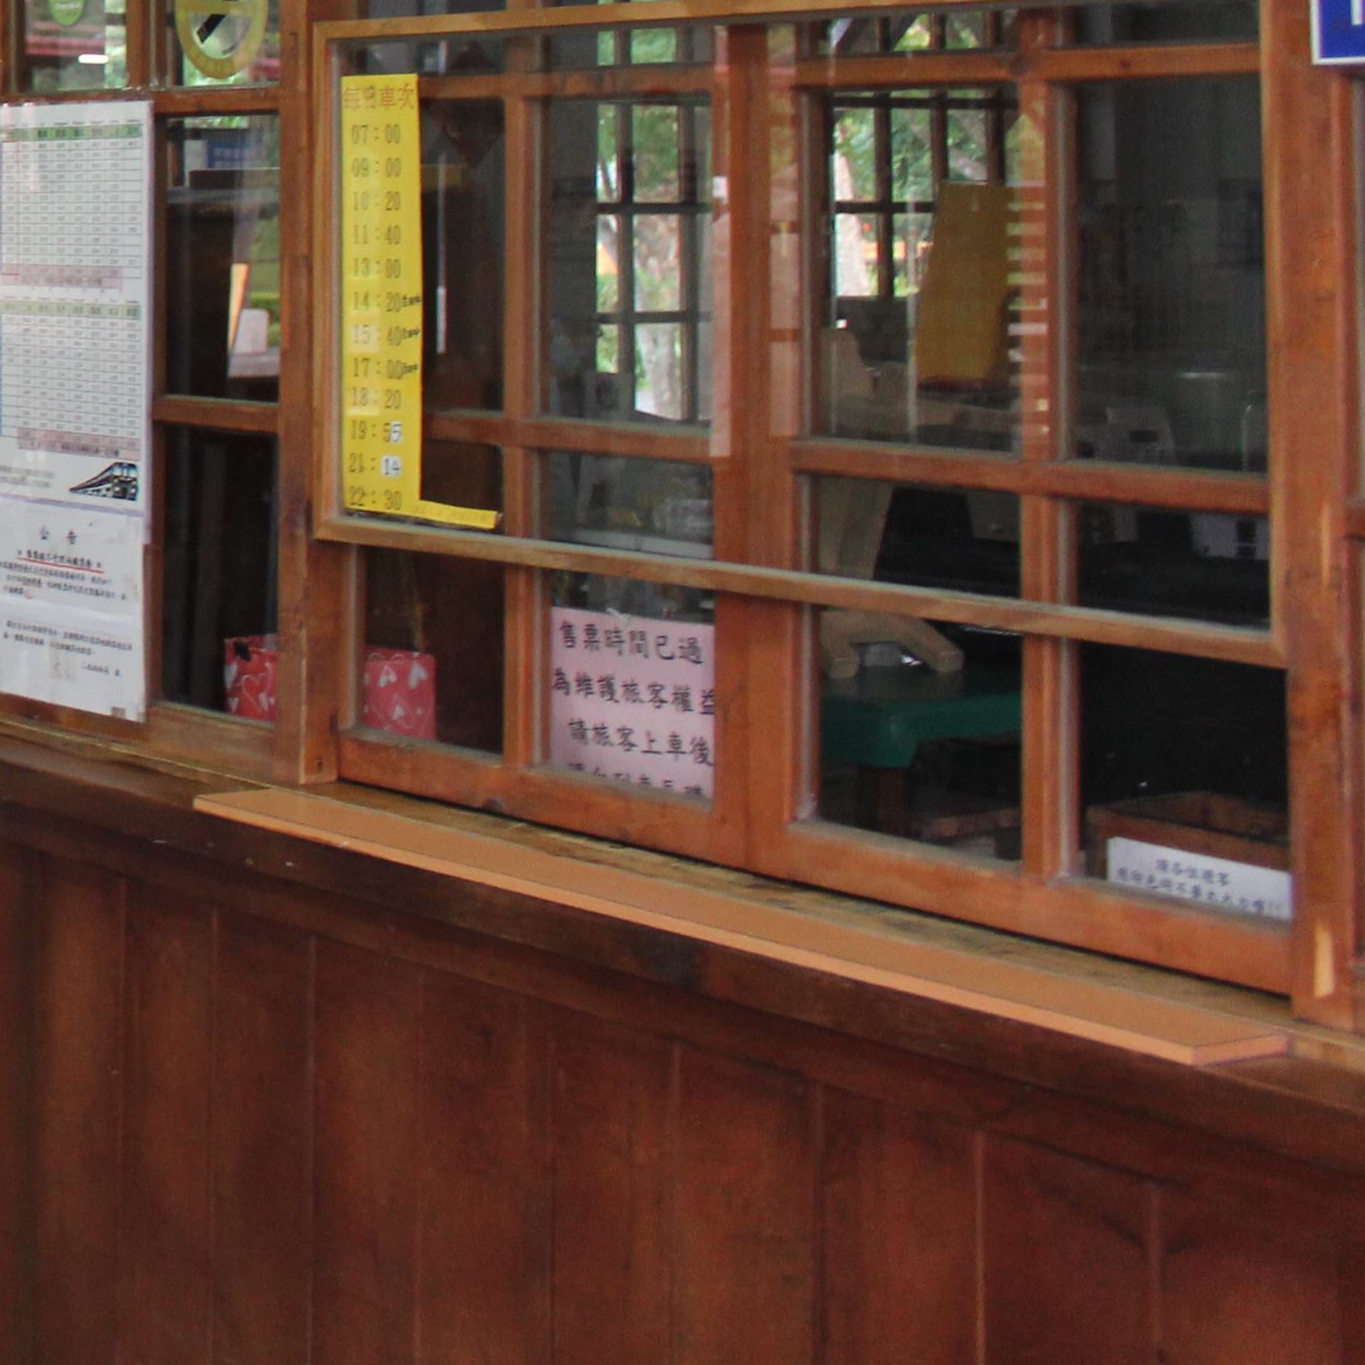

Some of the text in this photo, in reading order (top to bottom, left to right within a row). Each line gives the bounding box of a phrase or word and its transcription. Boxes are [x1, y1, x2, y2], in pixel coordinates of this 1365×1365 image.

[342, 82, 416, 111] 每日車次
[351, 123, 401, 144] 07:00
[352, 190, 401, 211] 10:20
[352, 223, 401, 245] 11:40
[352, 257, 401, 279] 13:00
[352, 357, 403, 380] 17:00
